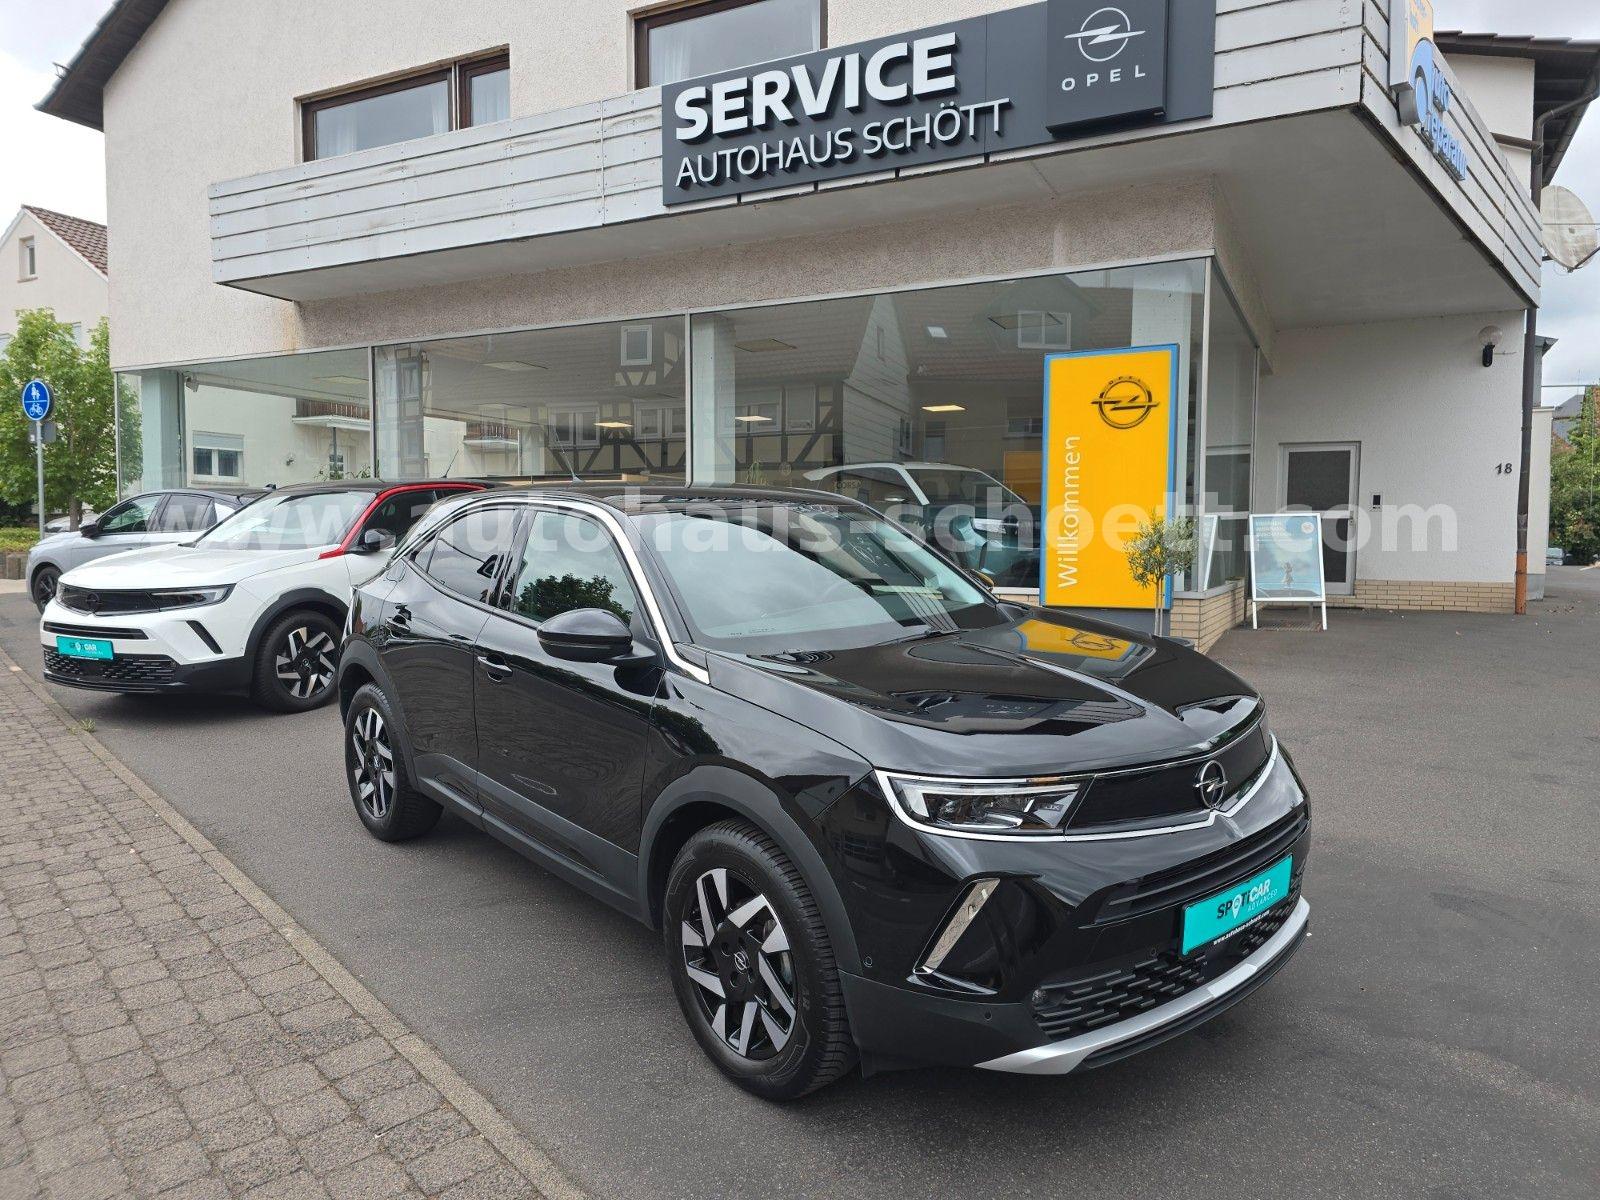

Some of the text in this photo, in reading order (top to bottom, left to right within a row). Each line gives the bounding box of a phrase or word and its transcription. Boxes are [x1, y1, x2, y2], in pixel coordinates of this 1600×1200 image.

[675, 32, 957, 141] SERVICE
[1061, 65, 1147, 92] OPEL
[675, 97, 1011, 187] AUTOHAUS SCHÖTT
[1057, 436, 1080, 588] Willkommen
[1495, 462, 1513, 475] 18
